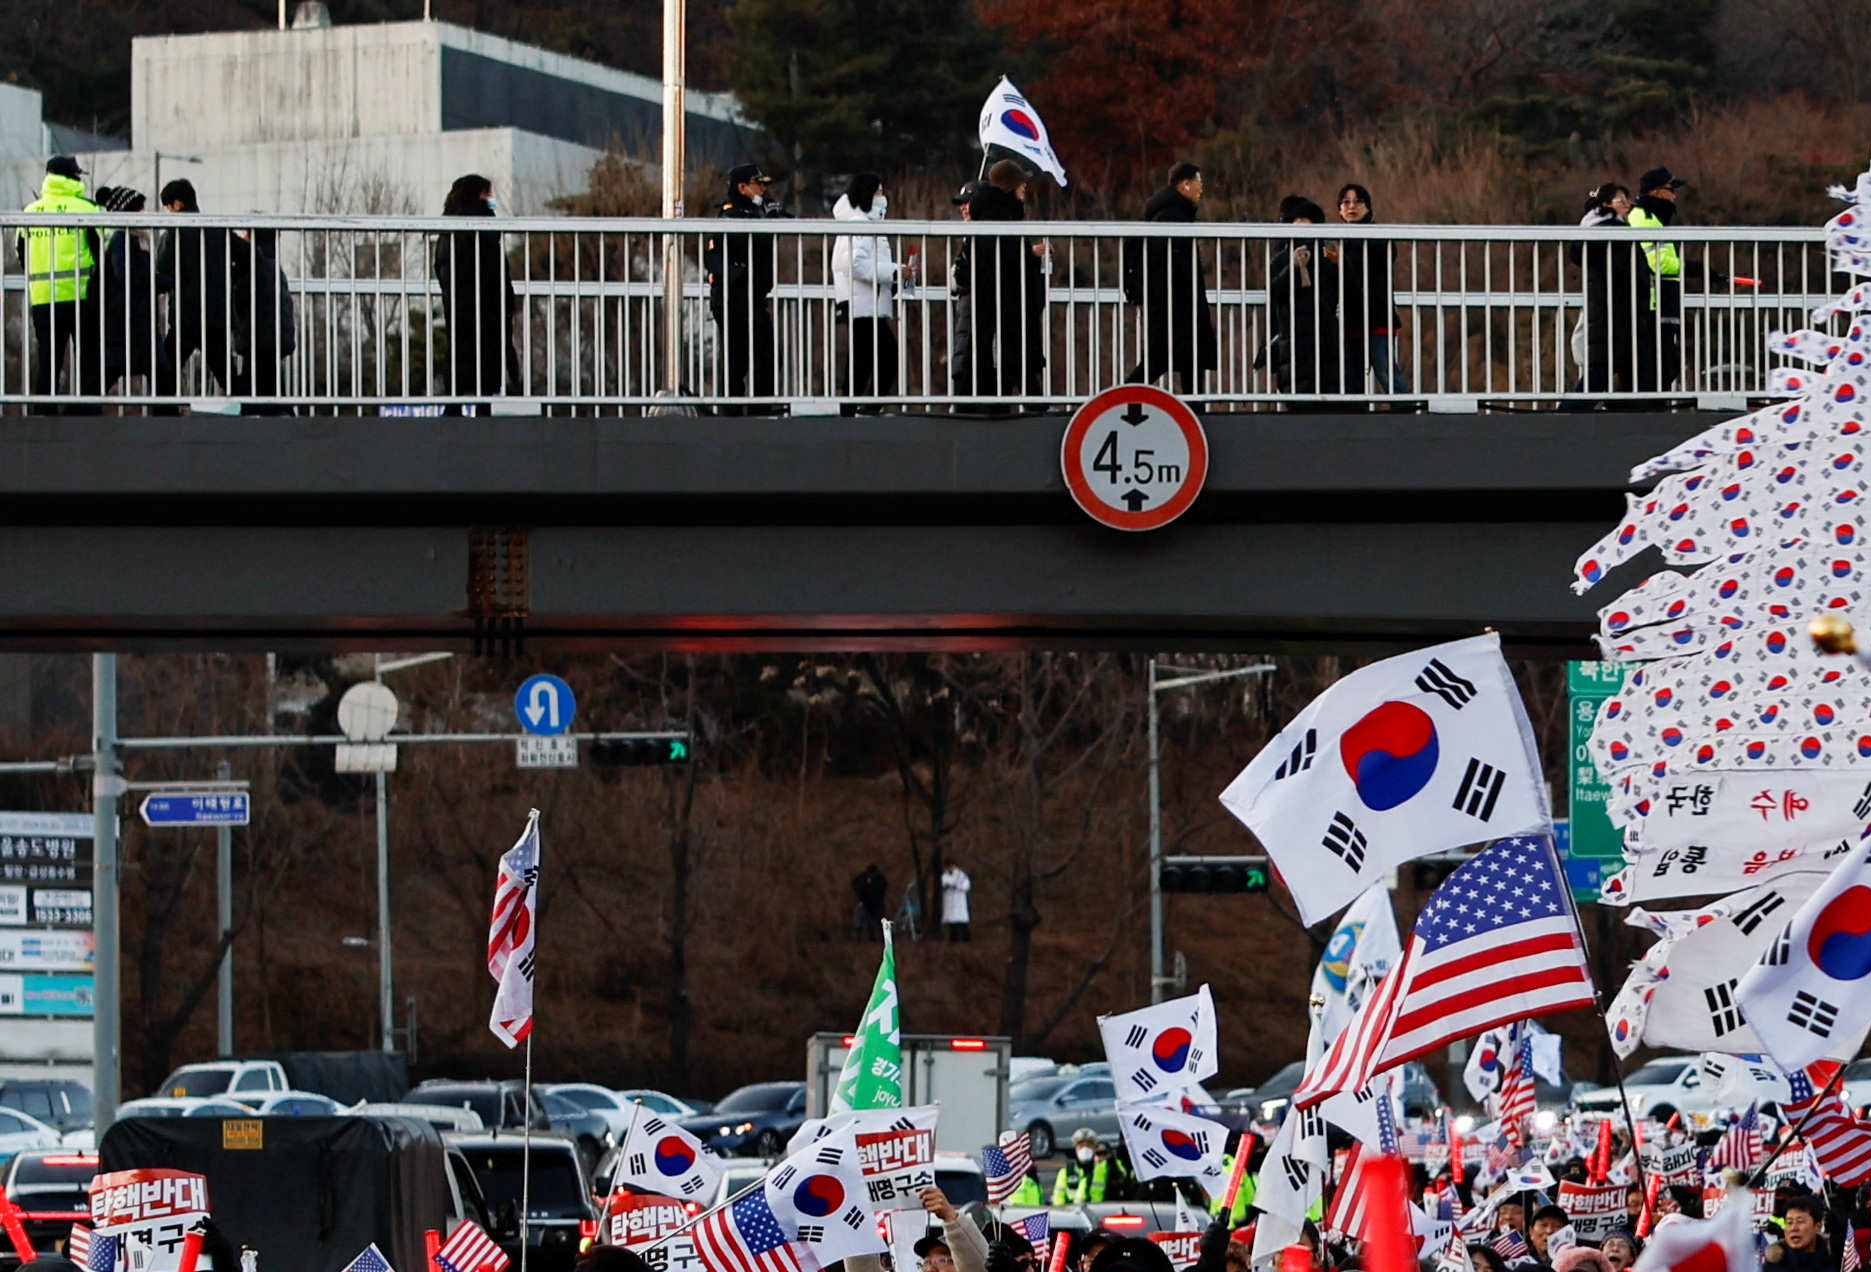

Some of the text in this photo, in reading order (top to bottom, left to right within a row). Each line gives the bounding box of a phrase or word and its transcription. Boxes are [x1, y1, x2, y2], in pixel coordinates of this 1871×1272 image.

[28, 227, 75, 238] POLCE
[1093, 431, 1180, 484] 4.5m
[1579, 661, 1641, 682] 북한
[1575, 788, 1613, 802] Itaew
[857, 1133, 930, 1172] 핵반대
[91, 1178, 208, 1228] 탄핵반대
[1558, 1188, 1627, 1214] 탄핵반대
[611, 1205, 692, 1246] 탄핵반
